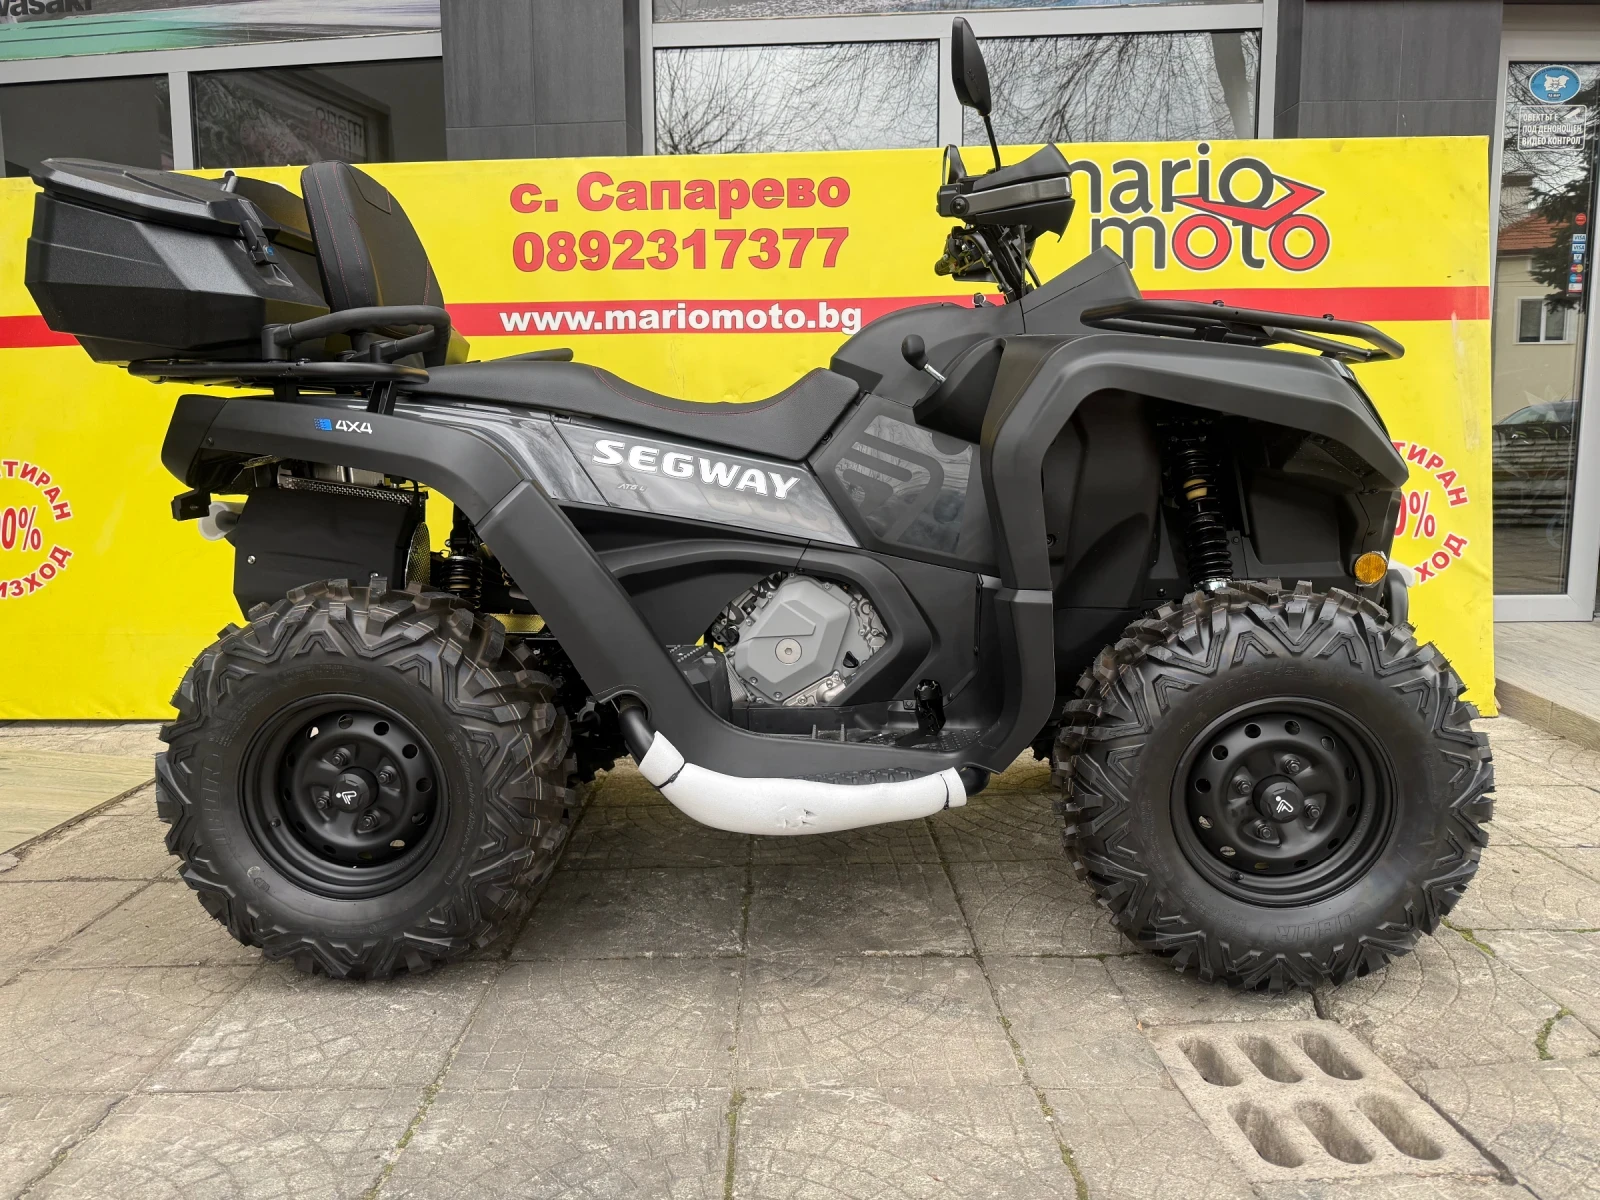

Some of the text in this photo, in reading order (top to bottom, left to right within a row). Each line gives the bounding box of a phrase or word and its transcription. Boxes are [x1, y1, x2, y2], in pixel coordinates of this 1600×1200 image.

[1521, 136, 1581, 146] ВИДЕО КОНТРОЛ
[1522, 124, 1537, 134] ПОД
[510, 171, 851, 219] с. Сапарево
[512, 227, 850, 272] 0892317377
[1090, 214, 1331, 271] moto
[499, 301, 863, 335] www.mariomoto.bg
[0, 460, 73, 521] ТИРАН
[592, 440, 800, 499] SEGWAY
[0, 506, 42, 551] 0%
